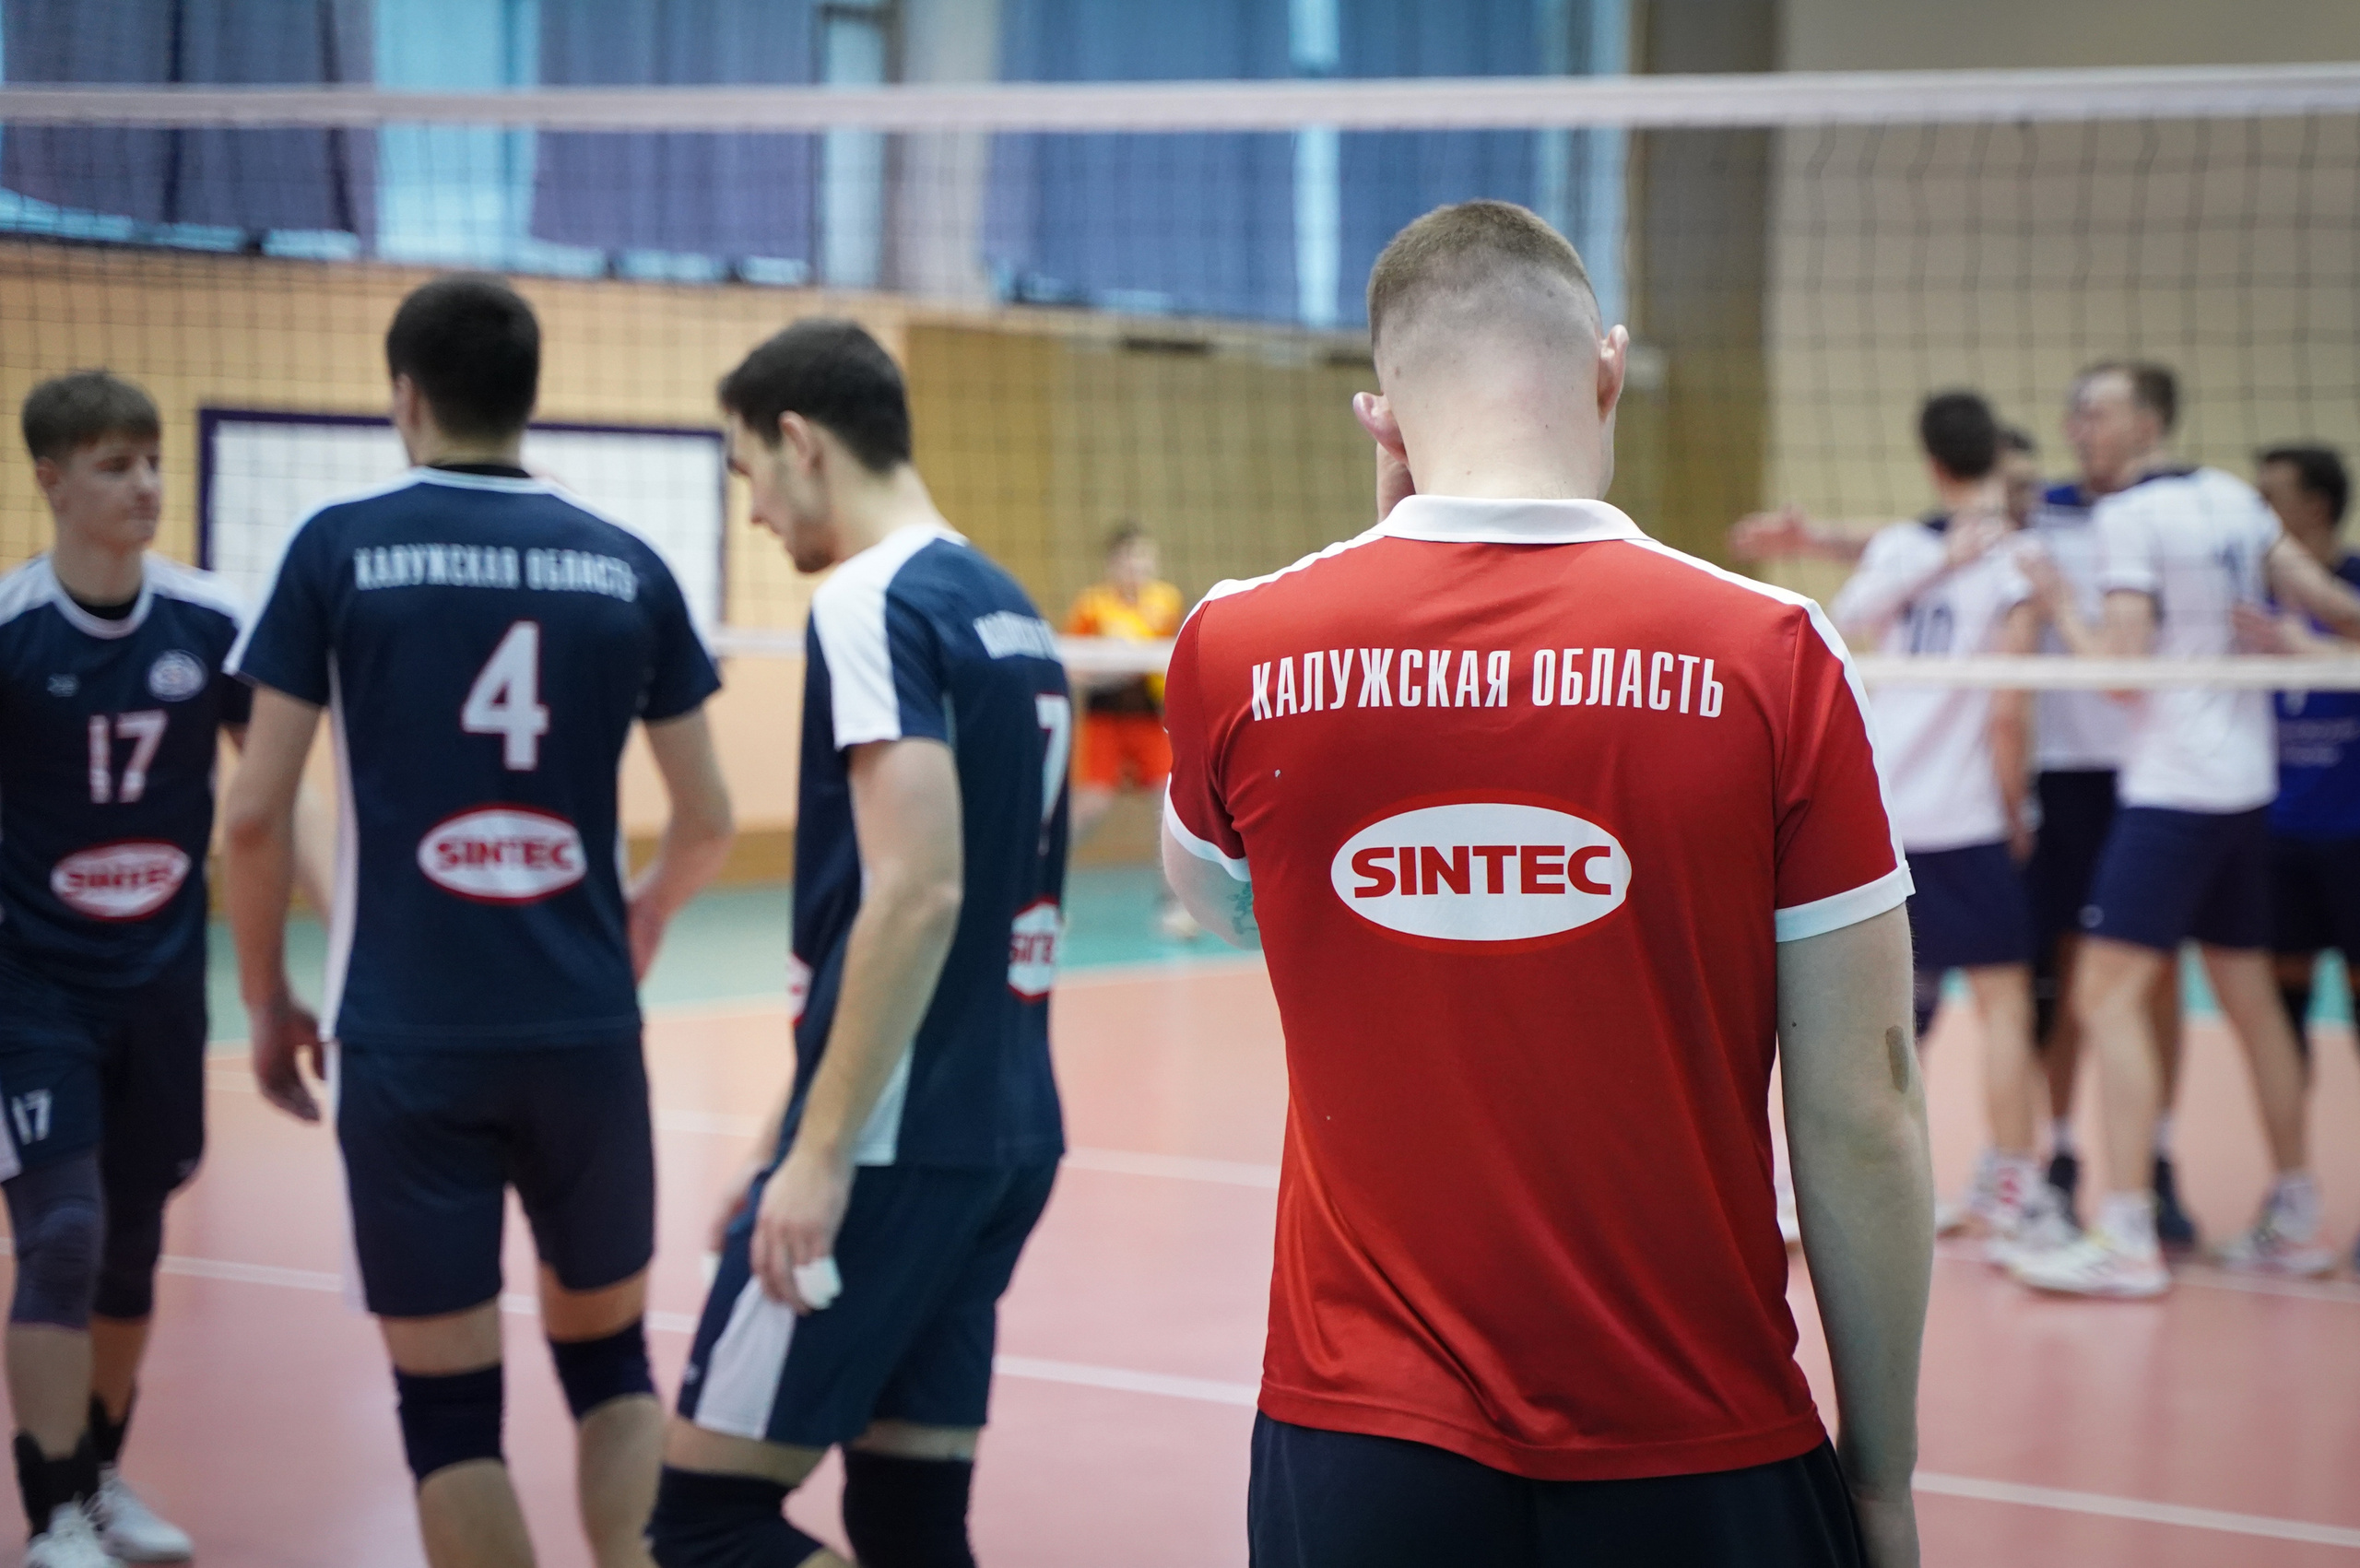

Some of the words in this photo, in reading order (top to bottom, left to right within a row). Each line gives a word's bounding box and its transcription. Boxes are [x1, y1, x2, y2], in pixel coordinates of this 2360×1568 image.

[462, 619, 549, 772] 4
[1251, 647, 1511, 721] КАЛУЖСКАЯ
[1532, 647, 1724, 718] ОБЛАСТЬ
[88, 709, 169, 804] 17
[437, 836, 574, 872] SINTEC
[1351, 844, 1611, 899] SINTEC
[12, 1089, 53, 1145] 17
